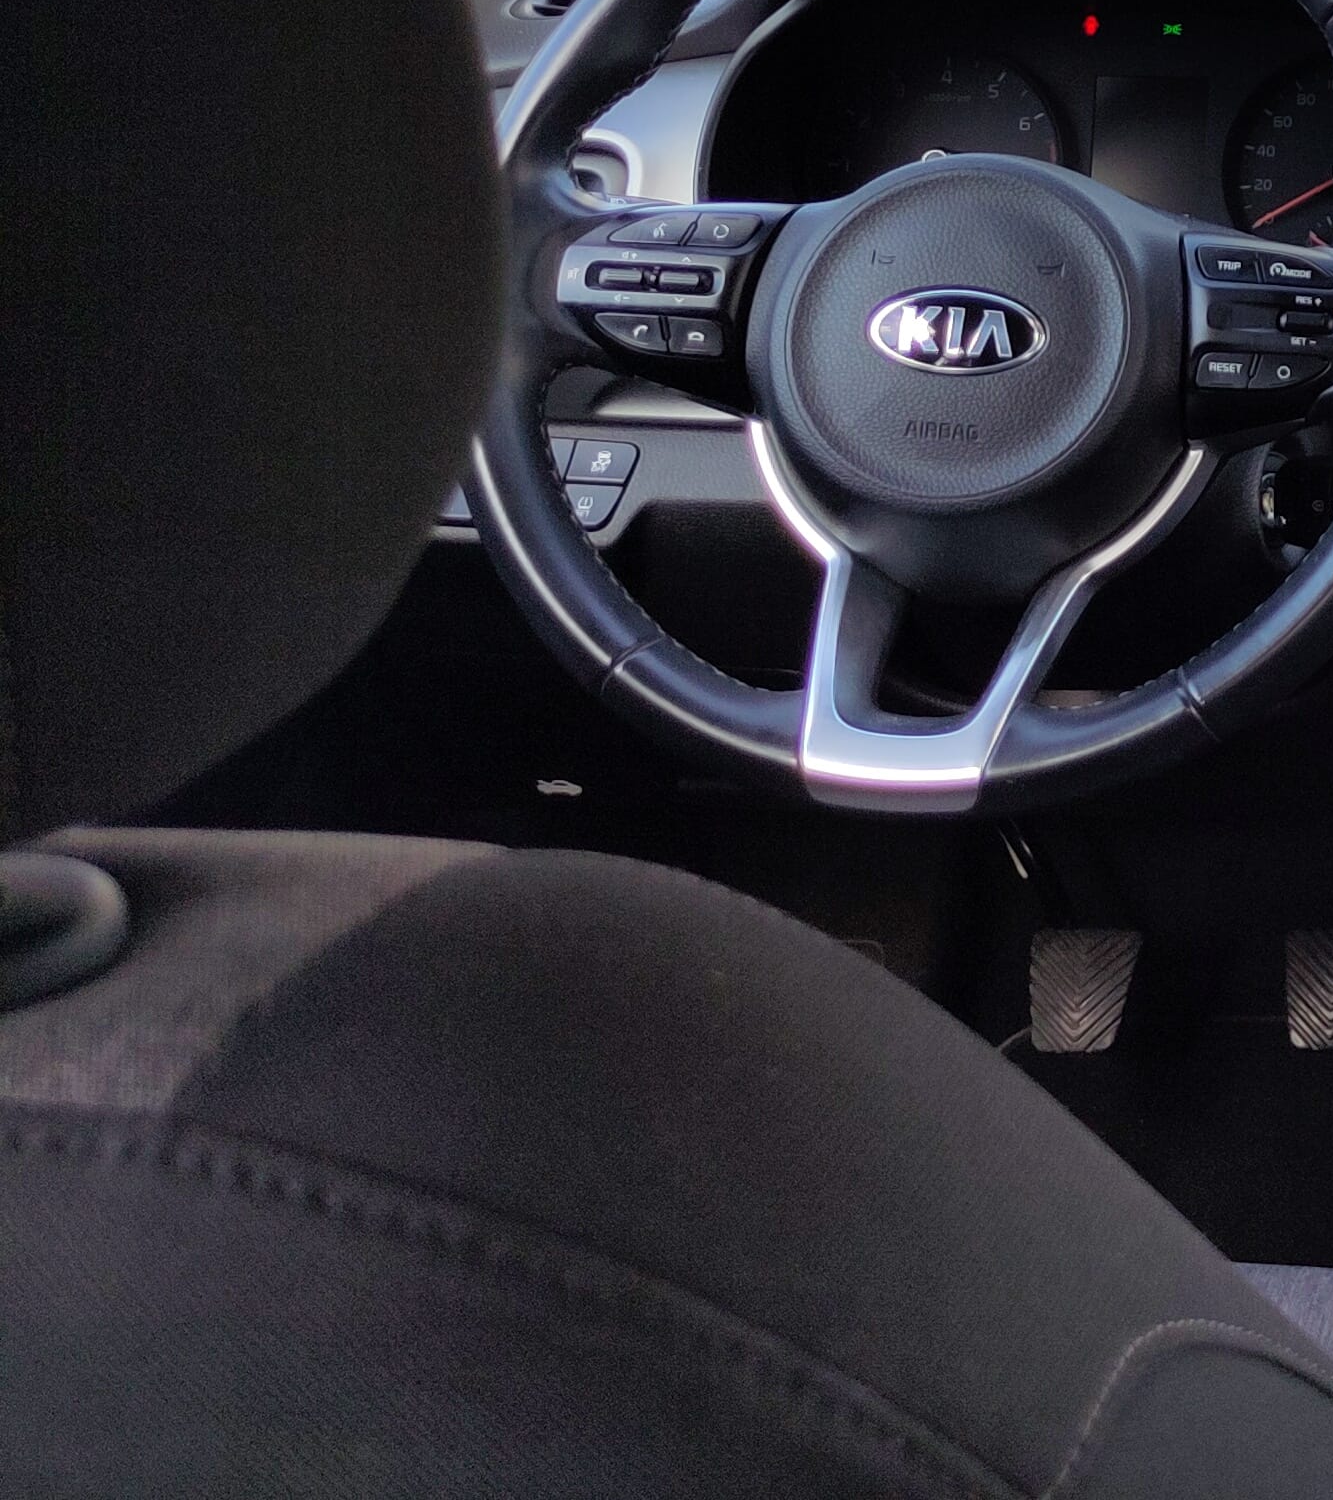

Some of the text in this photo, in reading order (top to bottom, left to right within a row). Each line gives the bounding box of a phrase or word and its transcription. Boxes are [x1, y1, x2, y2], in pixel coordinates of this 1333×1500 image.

[987, 84, 1000, 99] 5
[1296, 93, 1316, 106] 80
[1018, 116, 1031, 131] 6
[1272, 115, 1293, 128] 60
[1256, 144, 1276, 158] 40
[1253, 178, 1273, 191] 20
[1217, 259, 1242, 272] TRIP
[1284, 269, 1312, 279] MODE
[896, 305, 1013, 359] KIA
[1208, 361, 1243, 374] RESET
[903, 420, 980, 442] AIRBAG
